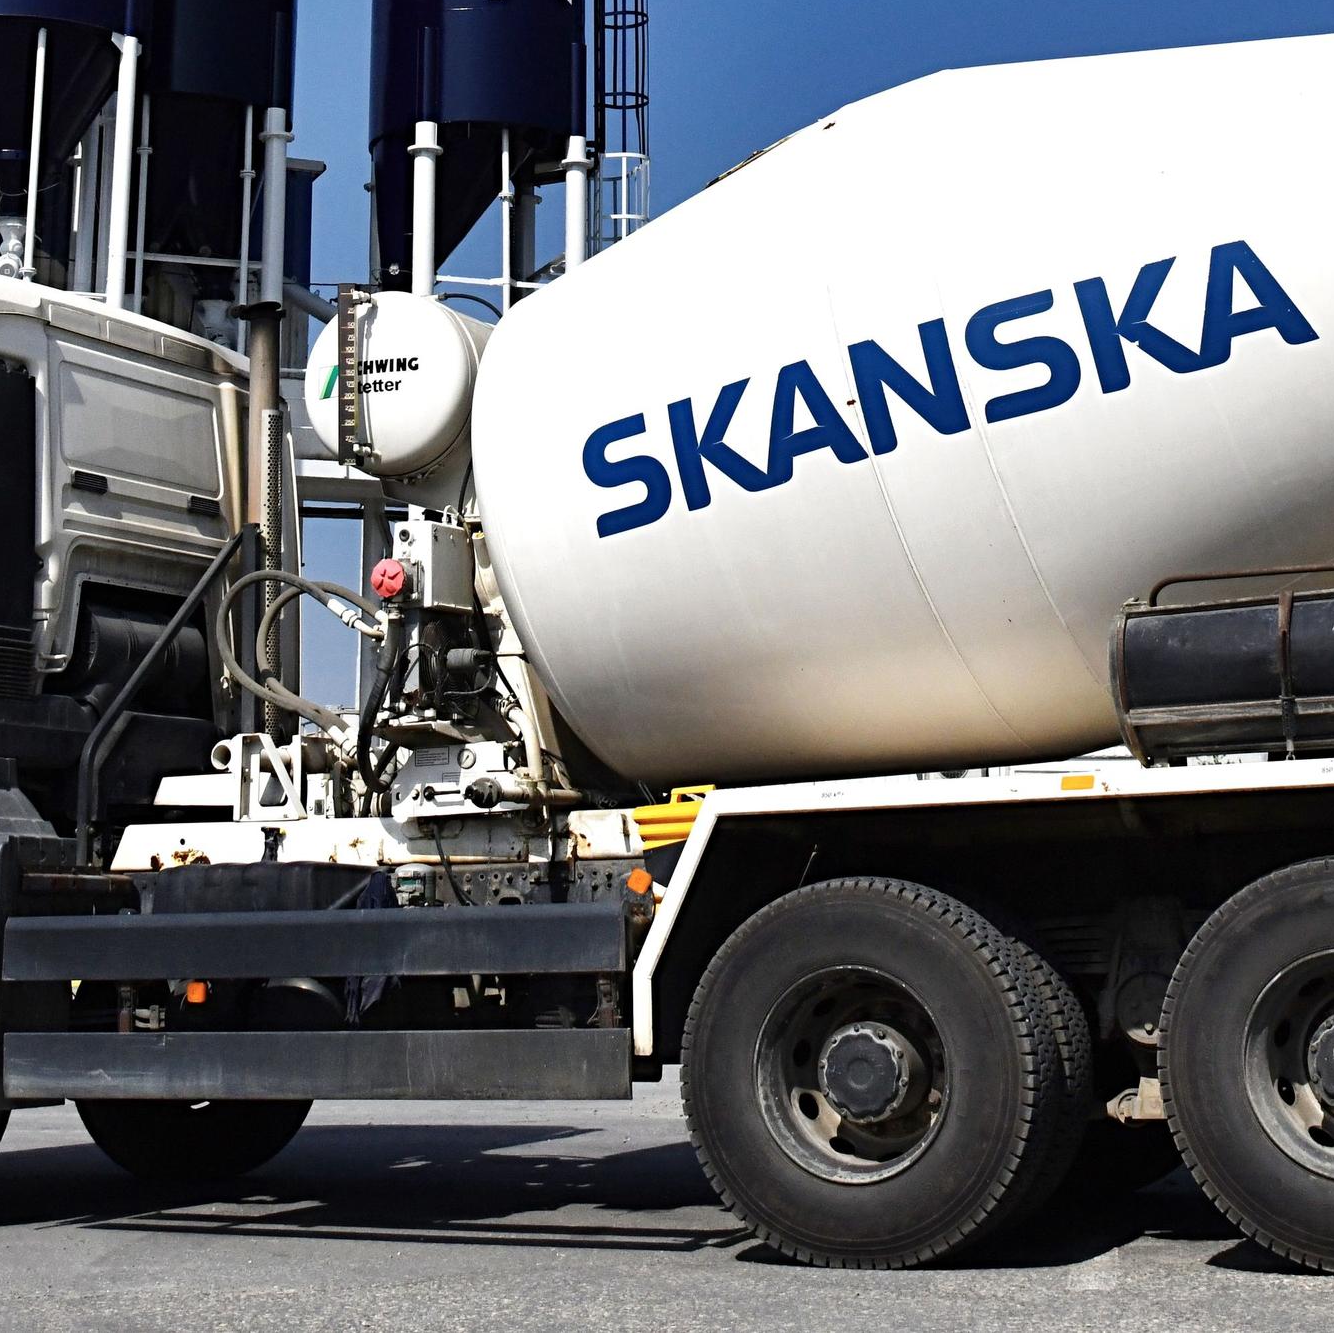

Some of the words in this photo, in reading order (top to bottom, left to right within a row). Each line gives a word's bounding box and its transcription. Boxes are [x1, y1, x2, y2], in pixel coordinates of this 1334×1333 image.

[357, 357, 419, 376] HWING
[357, 379, 402, 395] tetter
[581, 239, 1320, 538] SKANSKA
